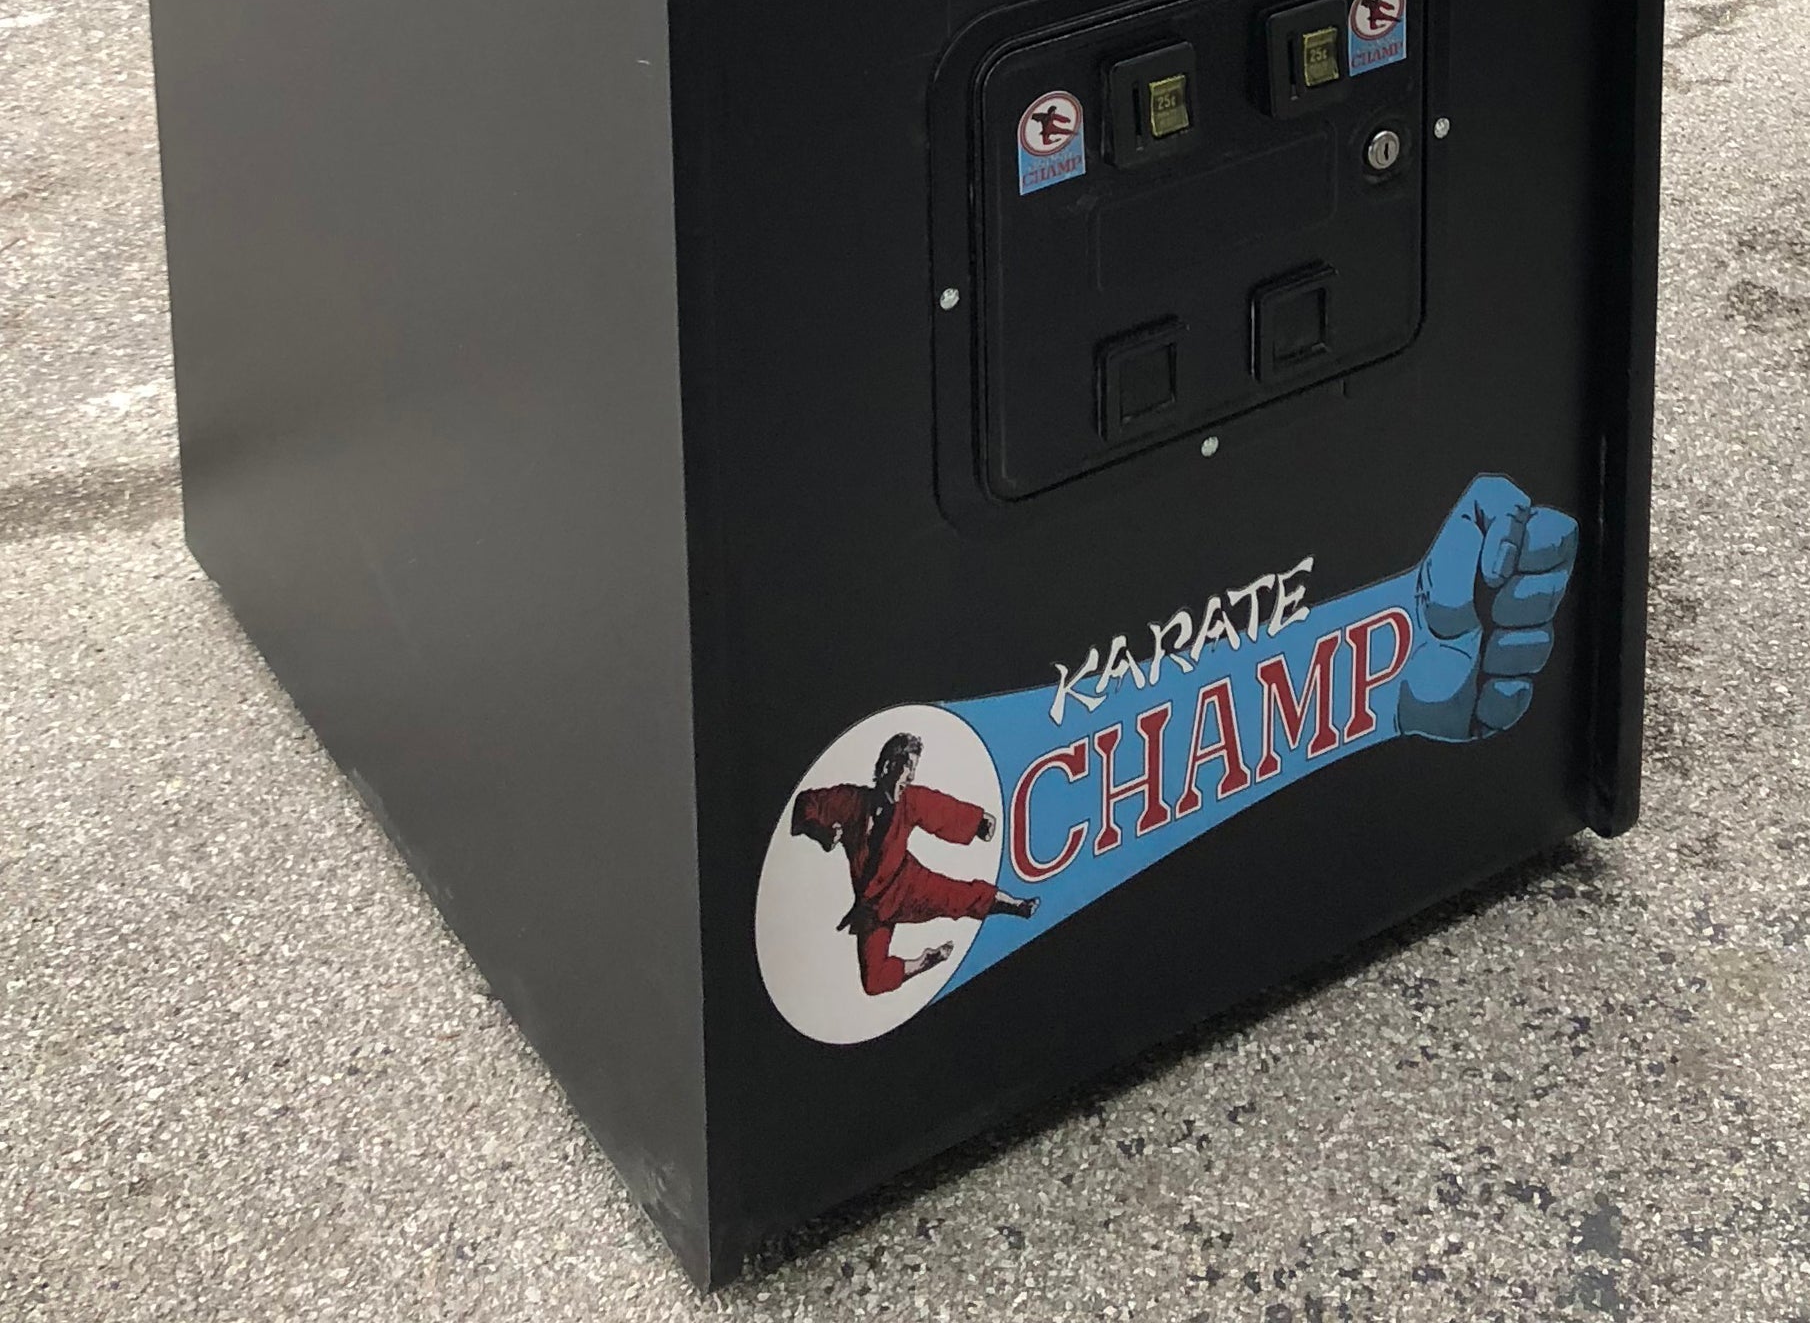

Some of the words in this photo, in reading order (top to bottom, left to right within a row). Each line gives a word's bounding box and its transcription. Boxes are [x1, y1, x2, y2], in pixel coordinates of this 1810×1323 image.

[1021, 156, 1082, 188] CHAMP
[1050, 557, 1316, 726] KARATE
[1009, 607, 1414, 885] CHAMP
